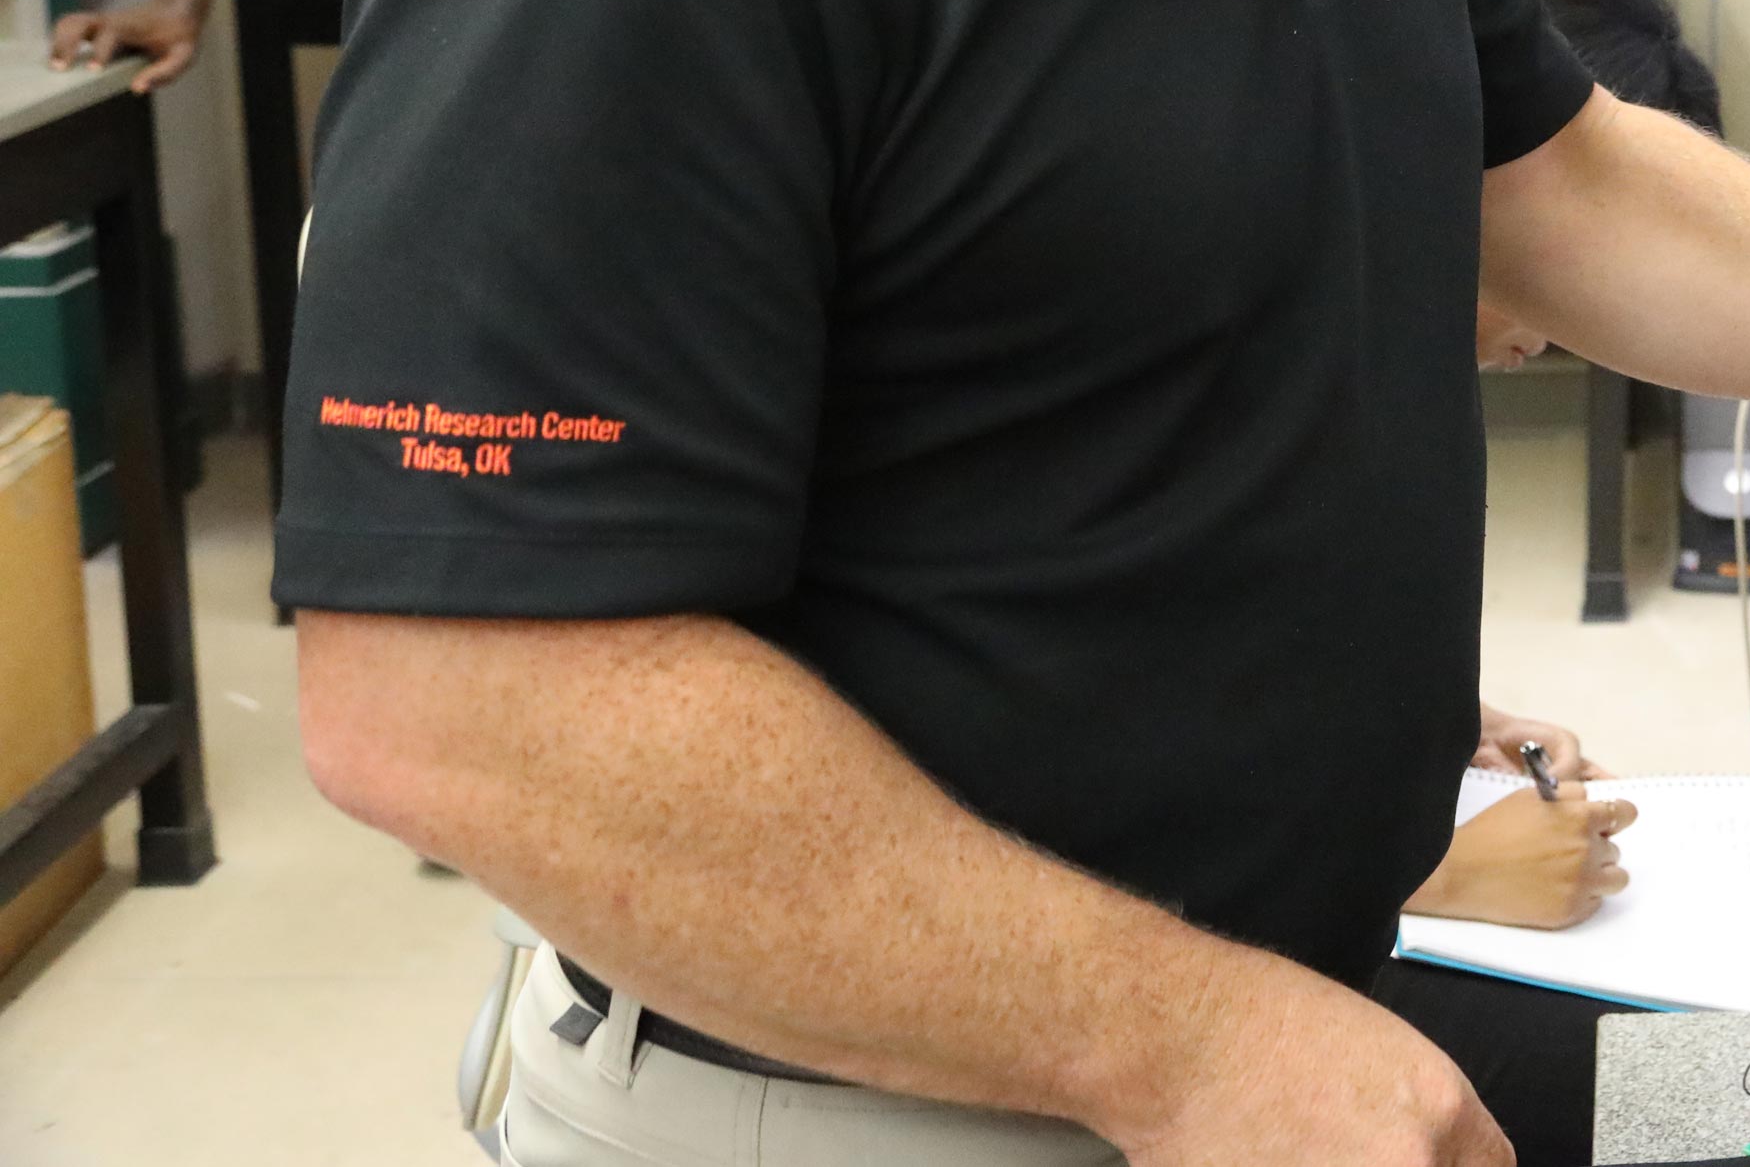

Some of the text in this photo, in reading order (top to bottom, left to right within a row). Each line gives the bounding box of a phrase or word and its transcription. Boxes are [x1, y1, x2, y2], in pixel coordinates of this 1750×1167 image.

[320, 396, 626, 443] Helmerich Research Center
[400, 436, 513, 477] Tulsa, OK
